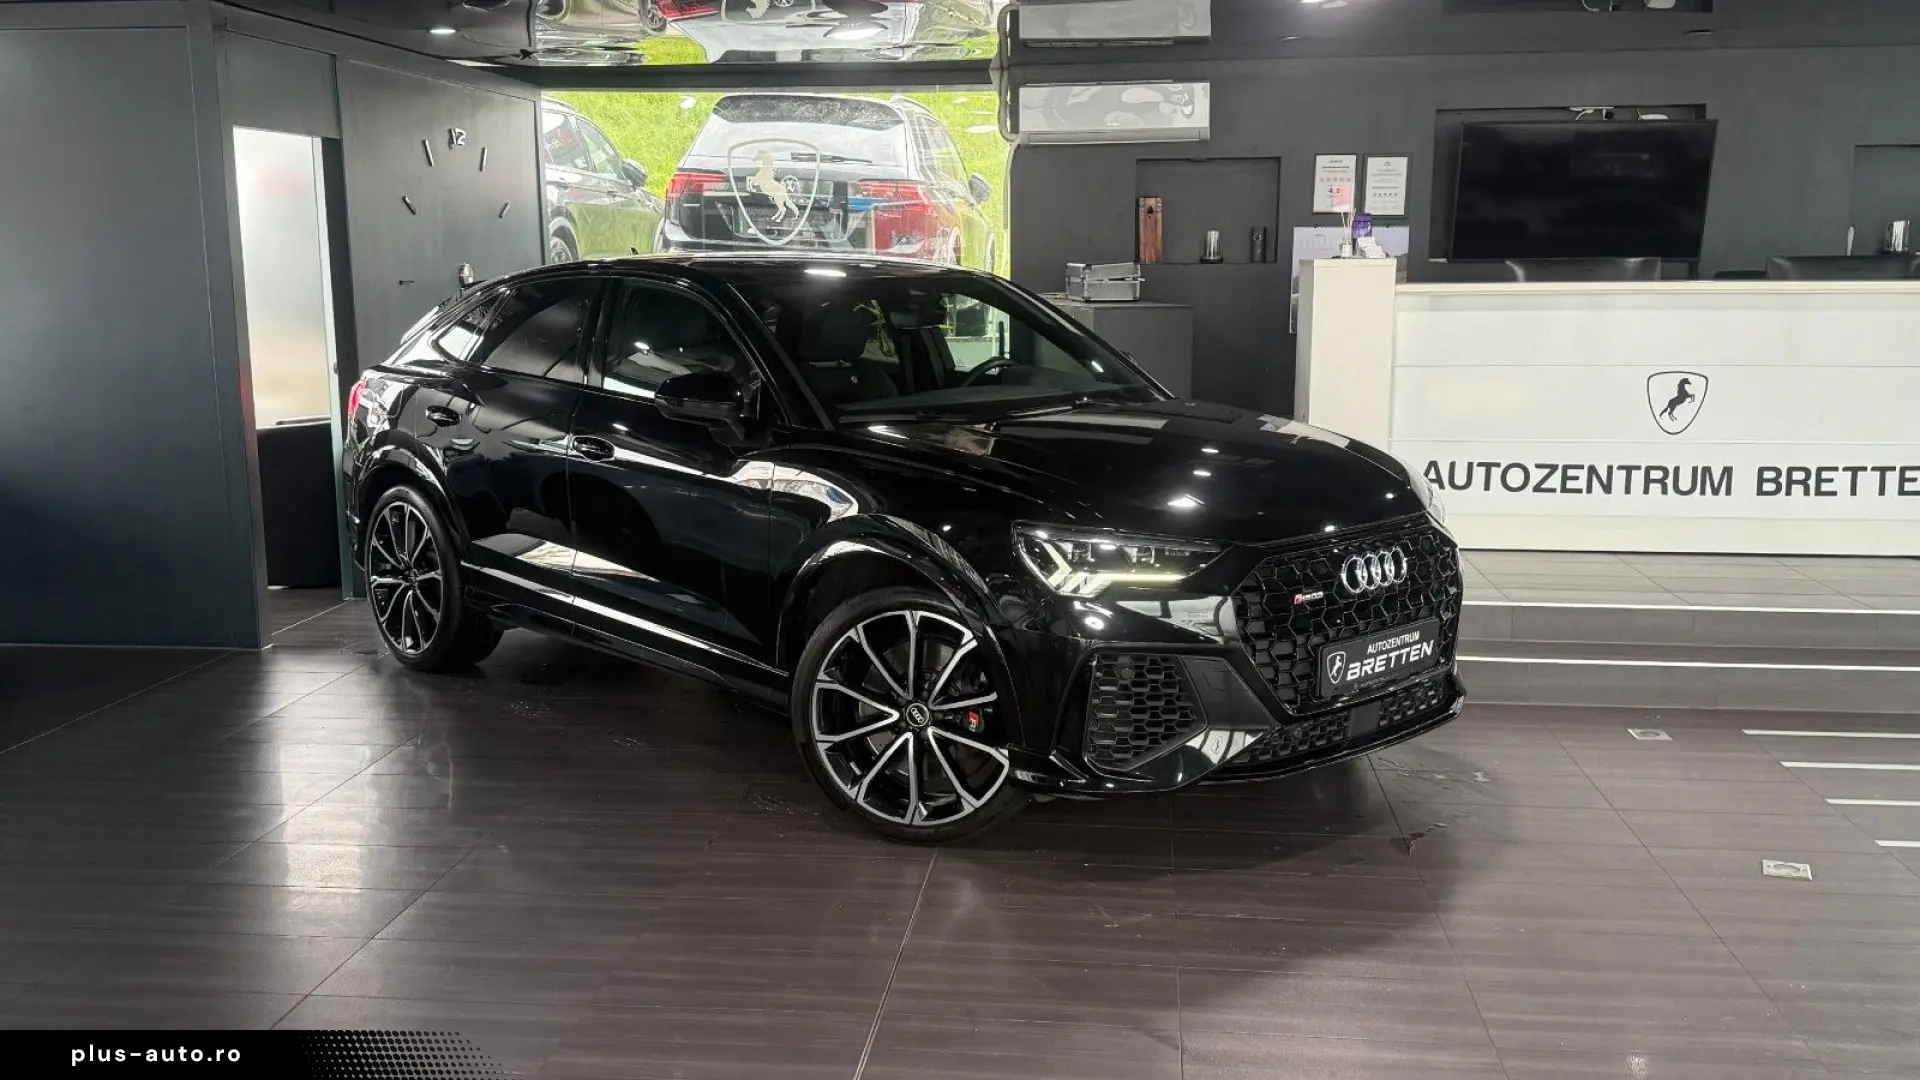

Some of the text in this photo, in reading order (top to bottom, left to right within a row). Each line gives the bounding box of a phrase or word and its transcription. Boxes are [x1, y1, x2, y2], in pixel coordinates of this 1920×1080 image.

[1423, 460, 1920, 497] AUTOZENTRUM BRETTE
[1346, 639, 1434, 681] BRETTEN
[1366, 630, 1420, 655] AUTOZENTRUM
